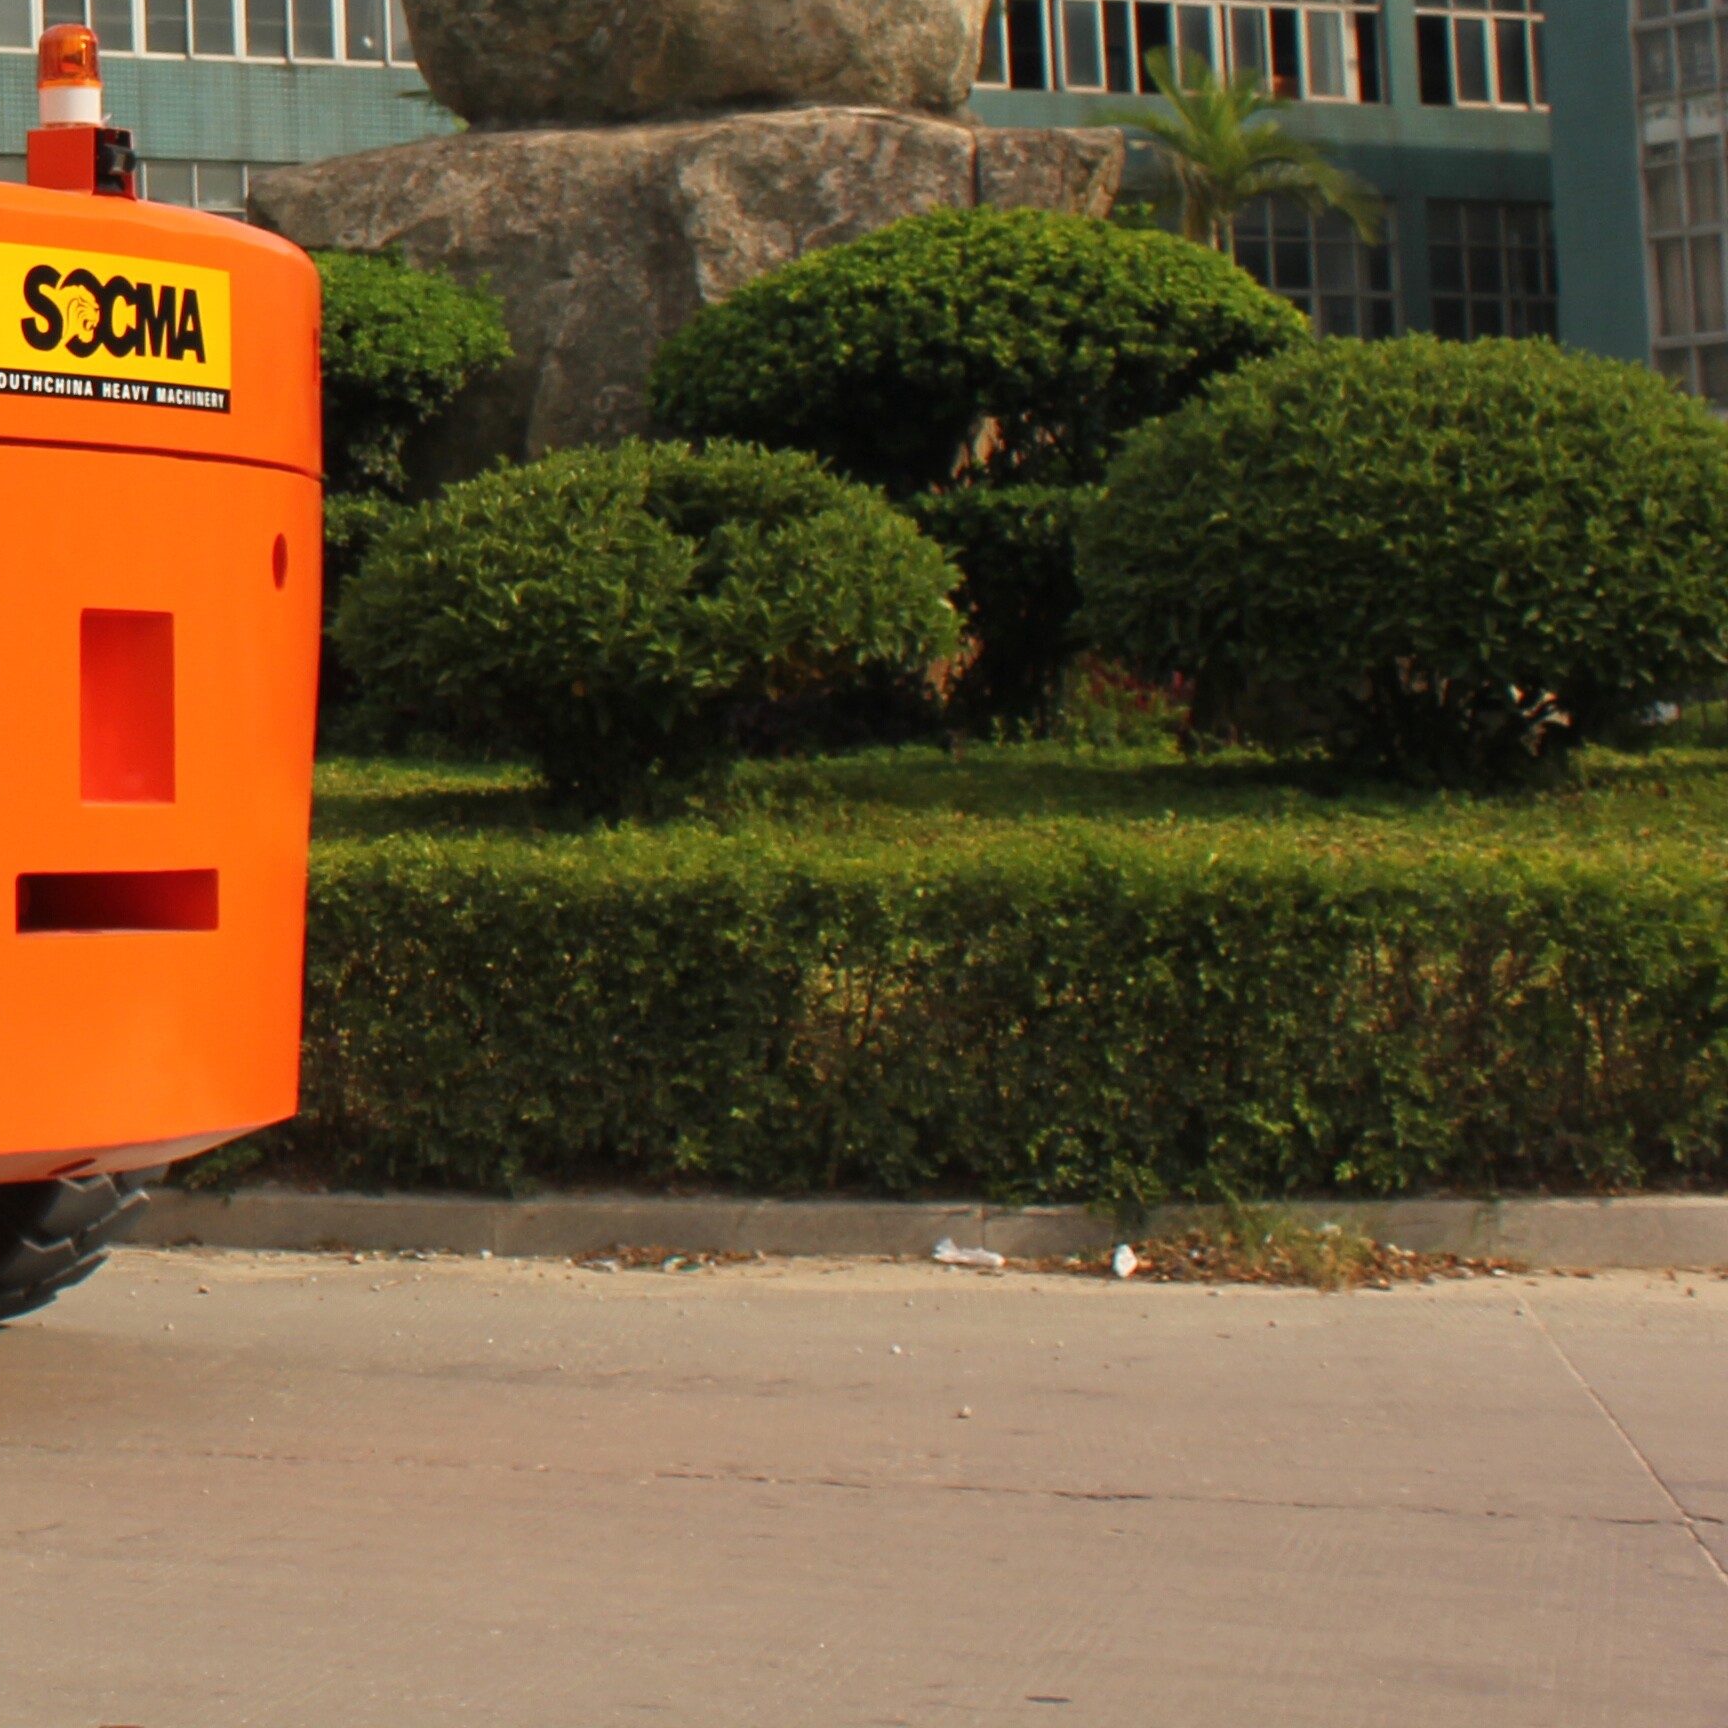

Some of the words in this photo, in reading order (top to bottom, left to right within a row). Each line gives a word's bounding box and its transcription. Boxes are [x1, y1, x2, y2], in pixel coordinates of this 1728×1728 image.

[21, 264, 206, 364] SOCMA
[101, 382, 150, 402] HEAVY
[155, 387, 226, 410] MACHINERY
